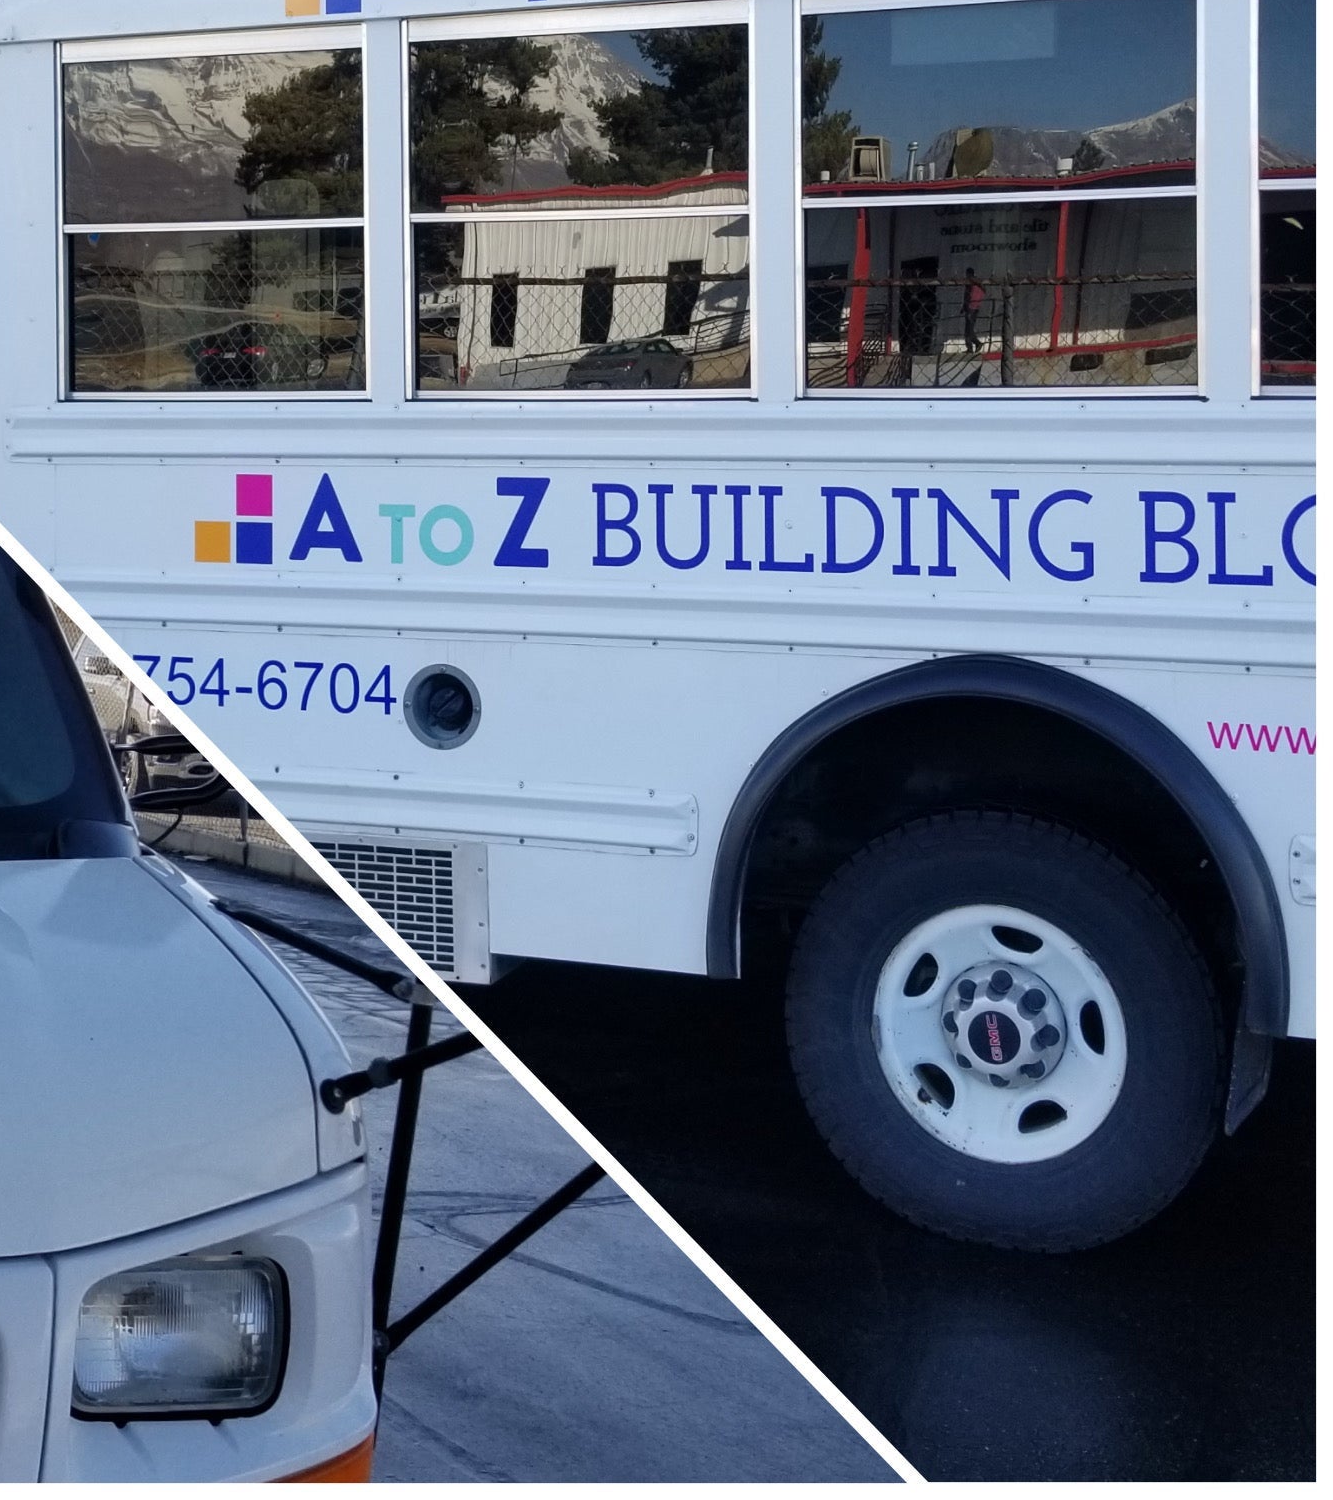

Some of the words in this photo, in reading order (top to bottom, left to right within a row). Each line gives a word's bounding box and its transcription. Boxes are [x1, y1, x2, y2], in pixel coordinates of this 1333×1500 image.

[287, 472, 364, 564] A
[493, 477, 551, 569] Z
[591, 482, 1096, 586] BUILDING
[985, 1014, 1003, 1062] GMC
